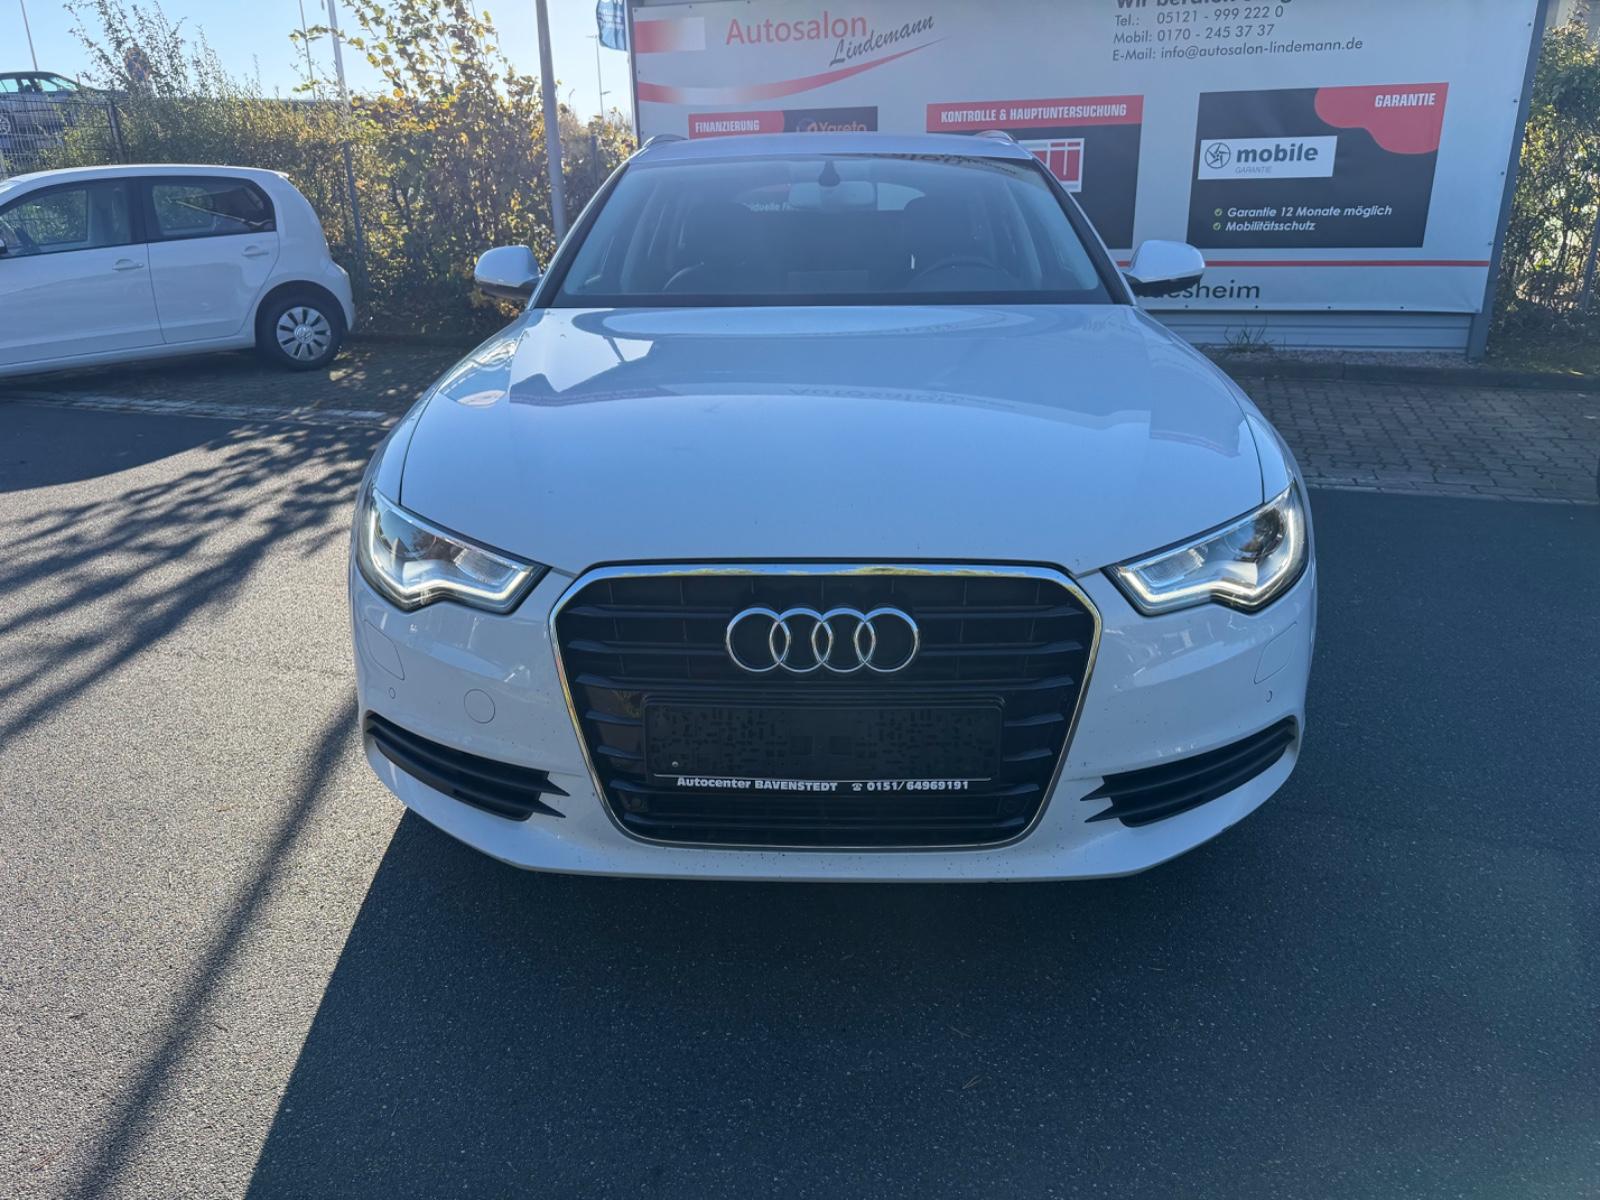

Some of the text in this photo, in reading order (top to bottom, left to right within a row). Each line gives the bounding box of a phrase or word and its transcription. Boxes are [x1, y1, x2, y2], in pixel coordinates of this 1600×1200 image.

[1114, 14, 1140, 27] Tel.:
[1156, 10, 1198, 25] 05121
[1213, 7, 1240, 21] 999
[1244, 5, 1270, 19] 222
[1274, 4, 1284, 18] 0
[726, 10, 867, 45] Autosalon
[1113, 30, 1152, 45] Mobil:
[1157, 28, 1191, 42] 0170
[1205, 25, 1231, 40] 245
[1234, 24, 1253, 38] 37
[1256, 23, 1275, 37] 37
[829, 15, 935, 67] Lindemann
[1112, 37, 1363, 62] E-Mail: info@autosalon-lindemann.de
[1375, 93, 1437, 108] GARANTIE
[941, 104, 1127, 123] KONTROLLE & HAUPTUNTERSUCHUNG
[695, 119, 760, 134] FINANZIERUNG
[1236, 143, 1319, 163] mobile
[1235, 166, 1273, 175] GARANTIE
[1227, 205, 1393, 219] Garantie 12 Monate möglich
[1225, 220, 1317, 232] Mobilitätsschutz
[677, 775, 969, 792] Autocenter BAVENSTEDT 0151/64969191
